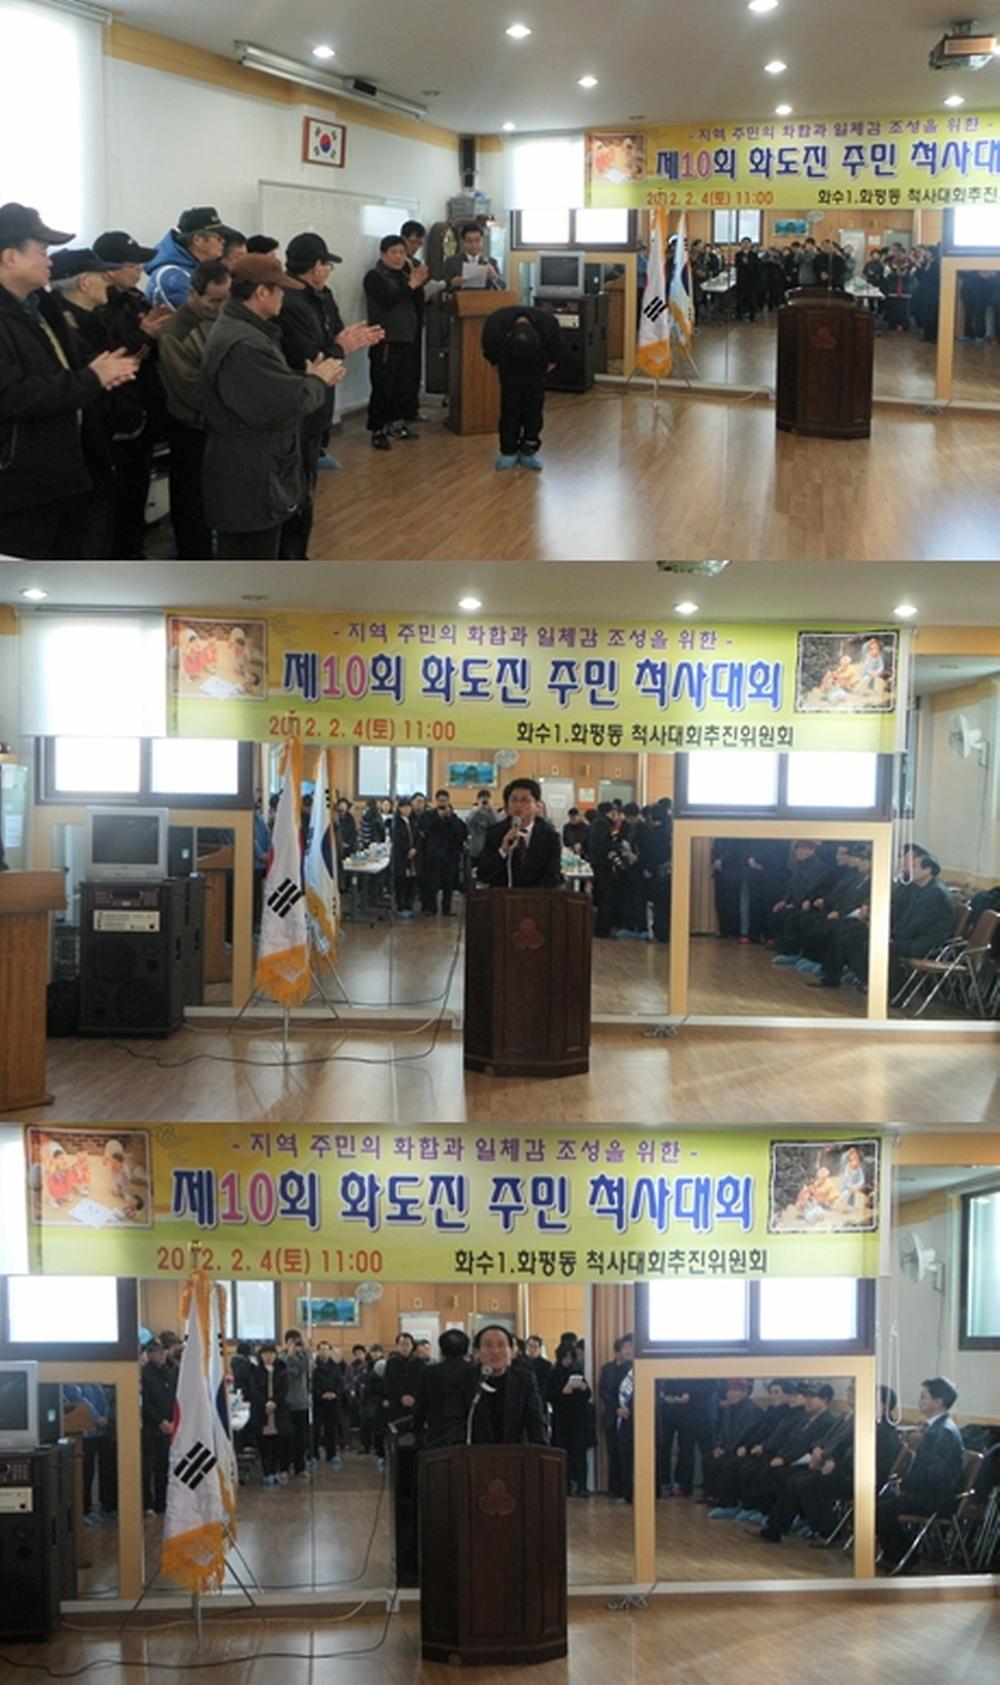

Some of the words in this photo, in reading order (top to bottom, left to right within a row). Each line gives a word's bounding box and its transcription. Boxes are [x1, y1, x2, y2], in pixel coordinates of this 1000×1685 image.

[699, 127, 726, 142] 지역
[732, 125, 775, 141] 주민의
[783, 123, 827, 139] 화합과
[833, 121, 881, 137] 일체감
[889, 118, 938, 135] 조성을
[948, 117, 979, 133] 위한
[656, 147, 737, 181] 제10회
[749, 145, 828, 179] 화도진
[842, 143, 897, 178] 주민
[736, 190, 774, 205] 11:00
[347, 622, 387, 644] 지역
[397, 624, 458, 646] 주민의
[467, 625, 529, 647] 화합과
[536, 626, 599, 649] 일체감
[607, 628, 669, 650] 조성을
[677, 629, 718, 650] 위한
[282, 652, 404, 704] 제10회
[420, 653, 531, 706] 화도진
[547, 657, 618, 709] 주민
[634, 657, 785, 711] 척사대회
[403, 720, 456, 741] 11:00
[631, 722, 794, 748] 척사대회추진위원회
[249, 1133, 299, 1158] 지역
[309, 1134, 381, 1160] 주민의
[393, 1136, 464, 1161] 화합과
[475, 1137, 546, 1162] 일체감
[556, 1138, 626, 1163] 조성을
[636, 1140, 681, 1164] 위한
[170, 1168, 320, 1230] 제10회
[340, 1170, 470, 1231] 화도진
[487, 1174, 571, 1232] 주민
[588, 1173, 754, 1233] 척사대회
[321, 1249, 383, 1273] 11:00
[585, 1248, 769, 1275] 척사대회추진위원회
